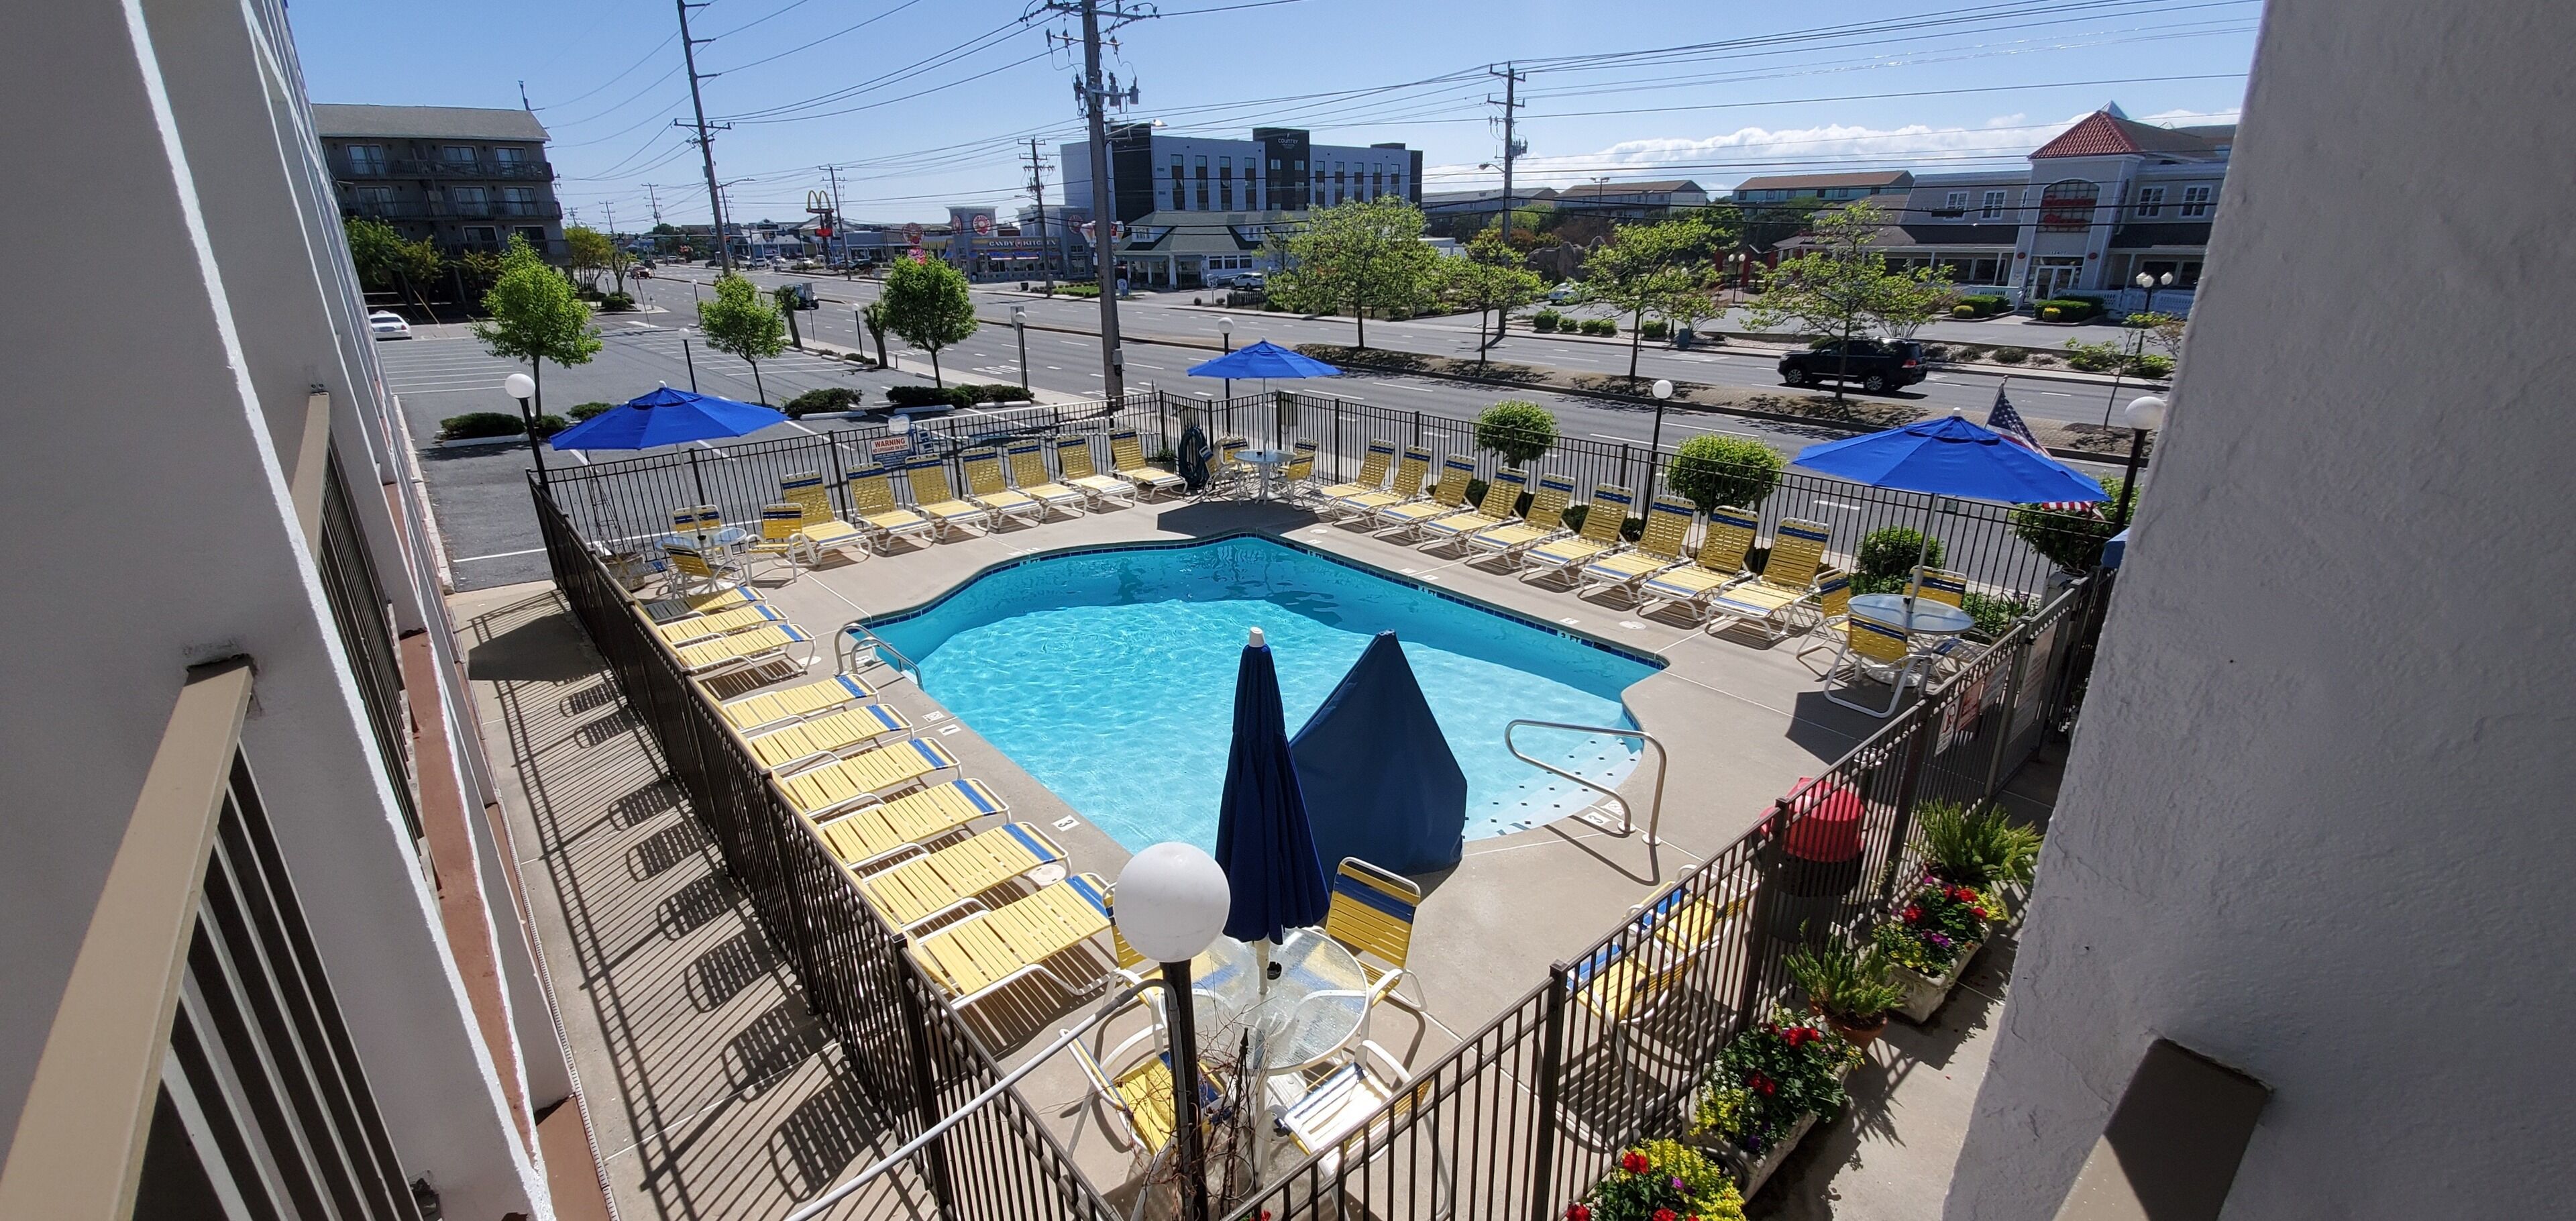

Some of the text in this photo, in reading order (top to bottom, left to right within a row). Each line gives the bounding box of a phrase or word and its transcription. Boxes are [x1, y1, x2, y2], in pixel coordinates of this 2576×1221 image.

[874, 438, 906, 447] WARNING
[1570, 635, 1580, 643] FT
[1057, 819, 1074, 828] 3
[1588, 815, 1604, 824] 3
